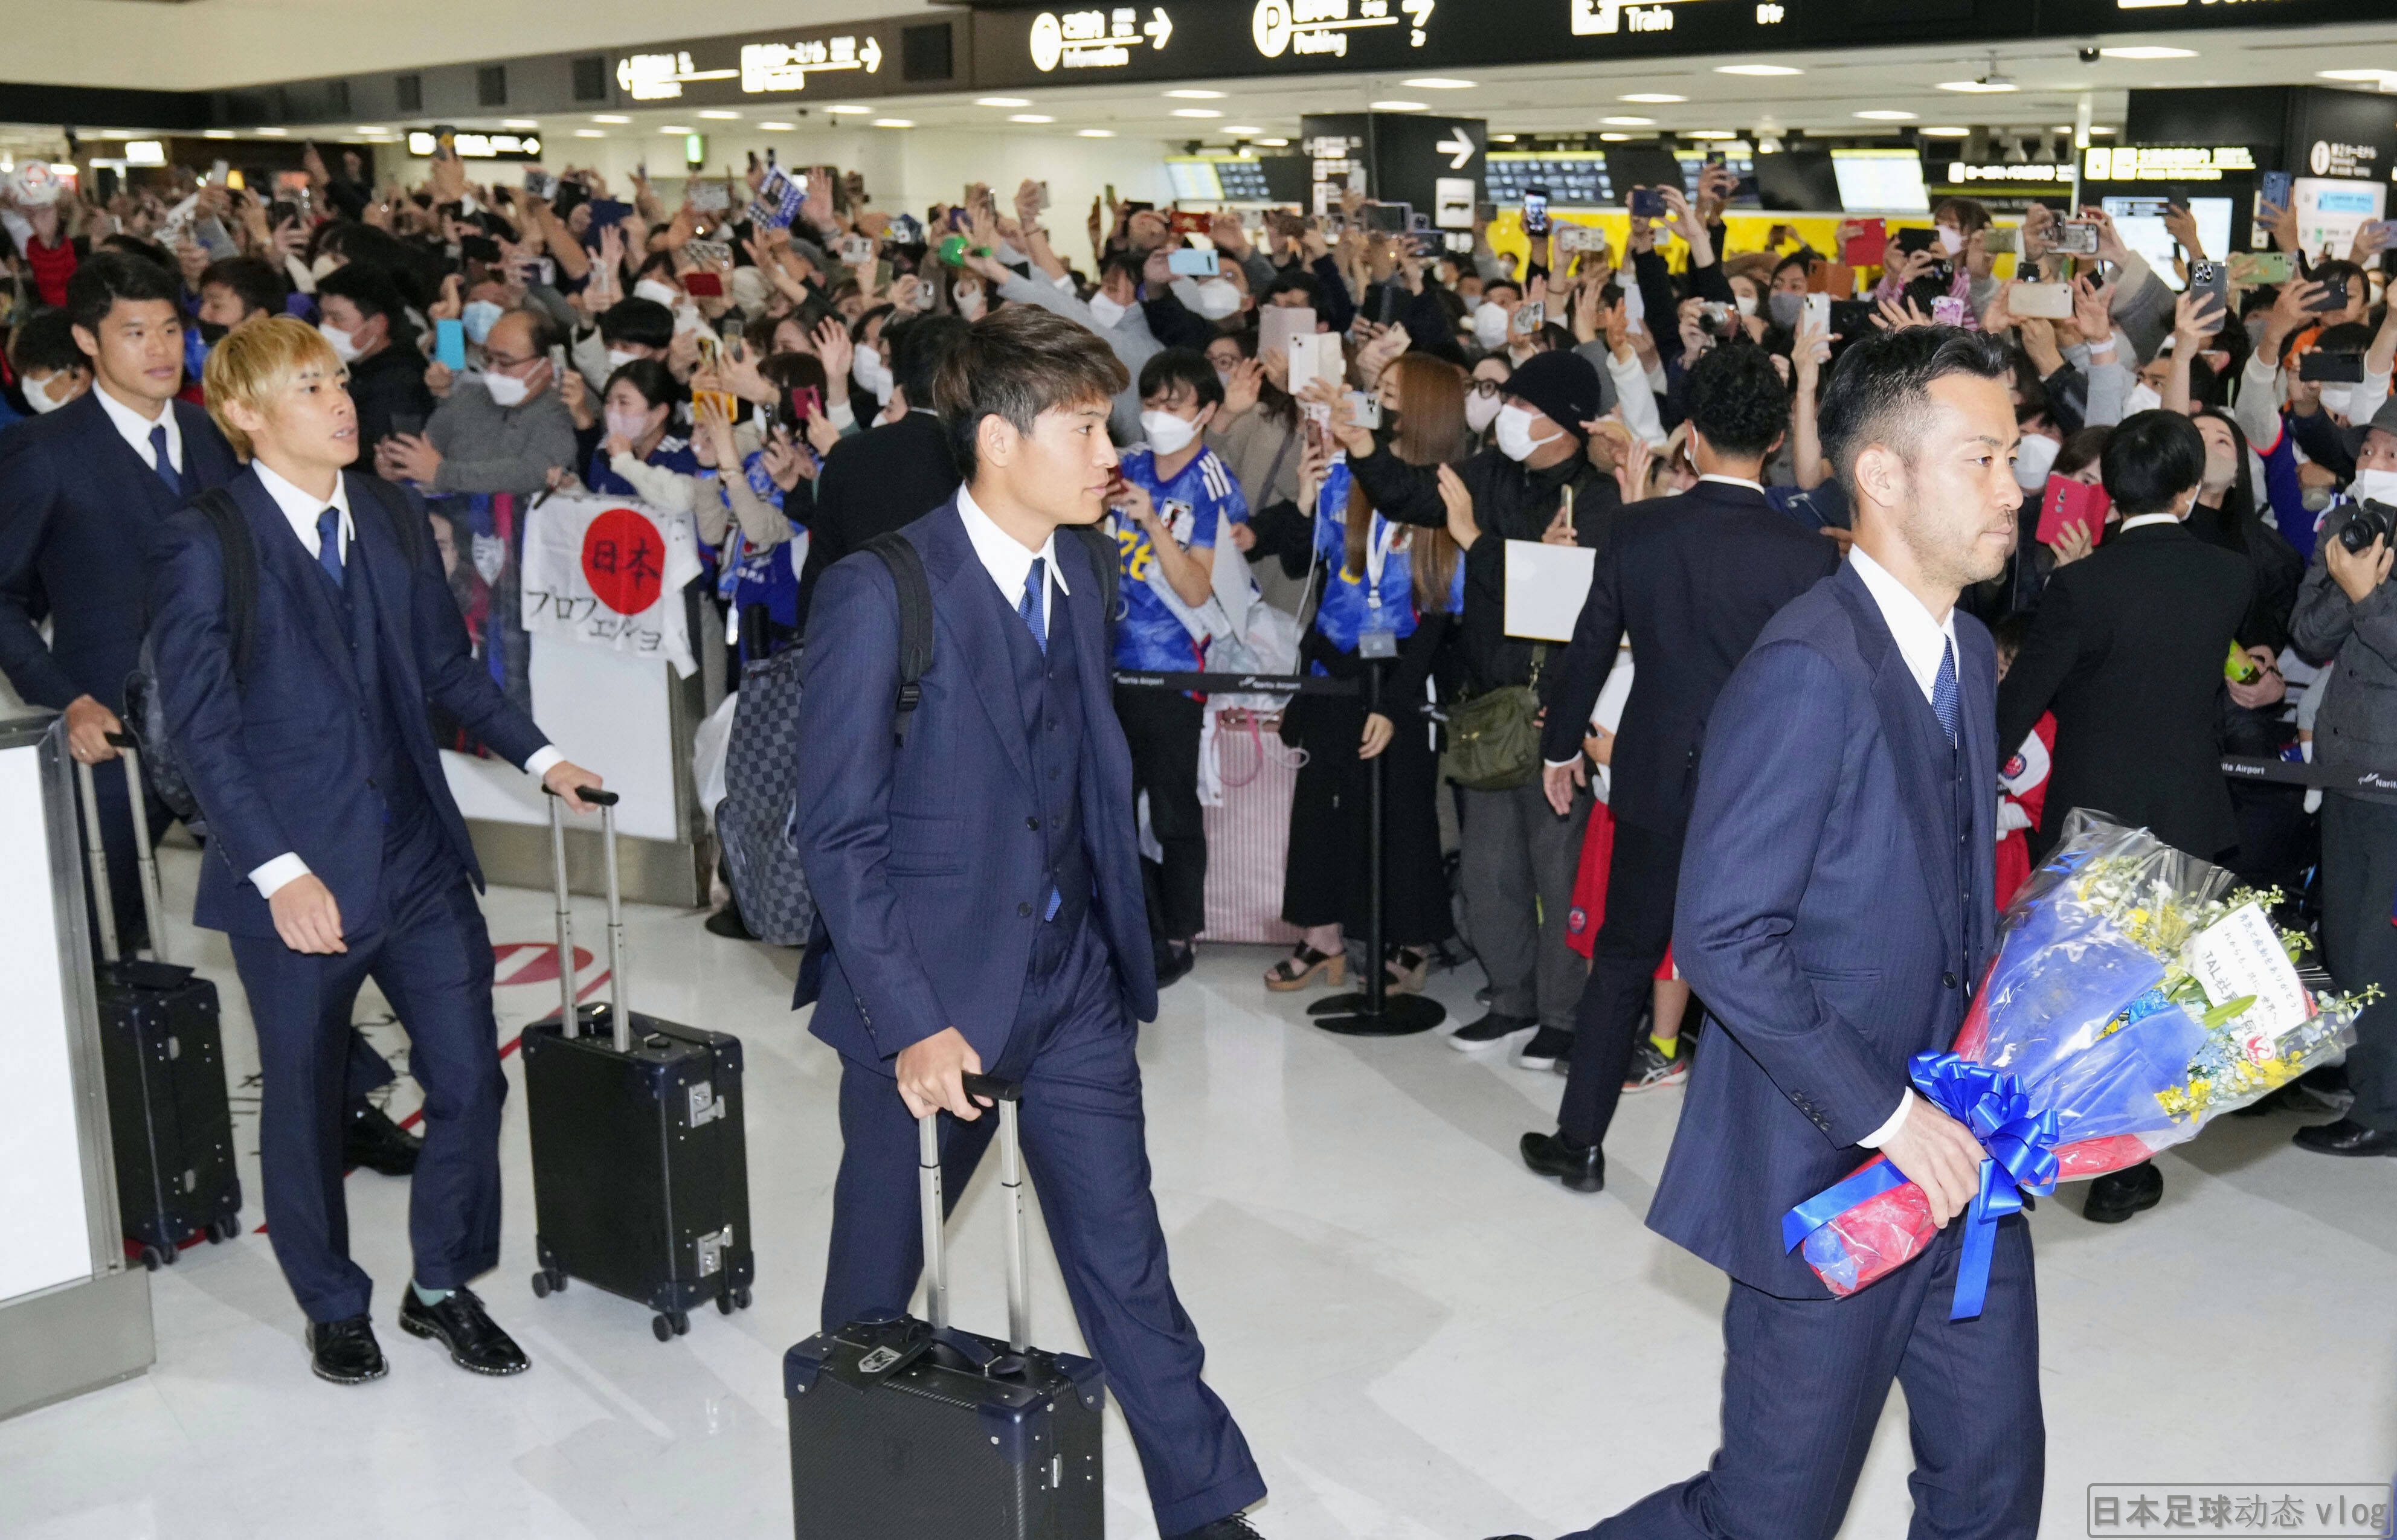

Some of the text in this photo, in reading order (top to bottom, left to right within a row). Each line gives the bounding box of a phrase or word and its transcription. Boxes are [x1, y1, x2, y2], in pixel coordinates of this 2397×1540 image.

[1625, 5, 1673, 33] Train
[593, 539, 661, 587] 日本
[2235, 763, 2265, 775] Airport
[2375, 778, 2397, 788] Narit
